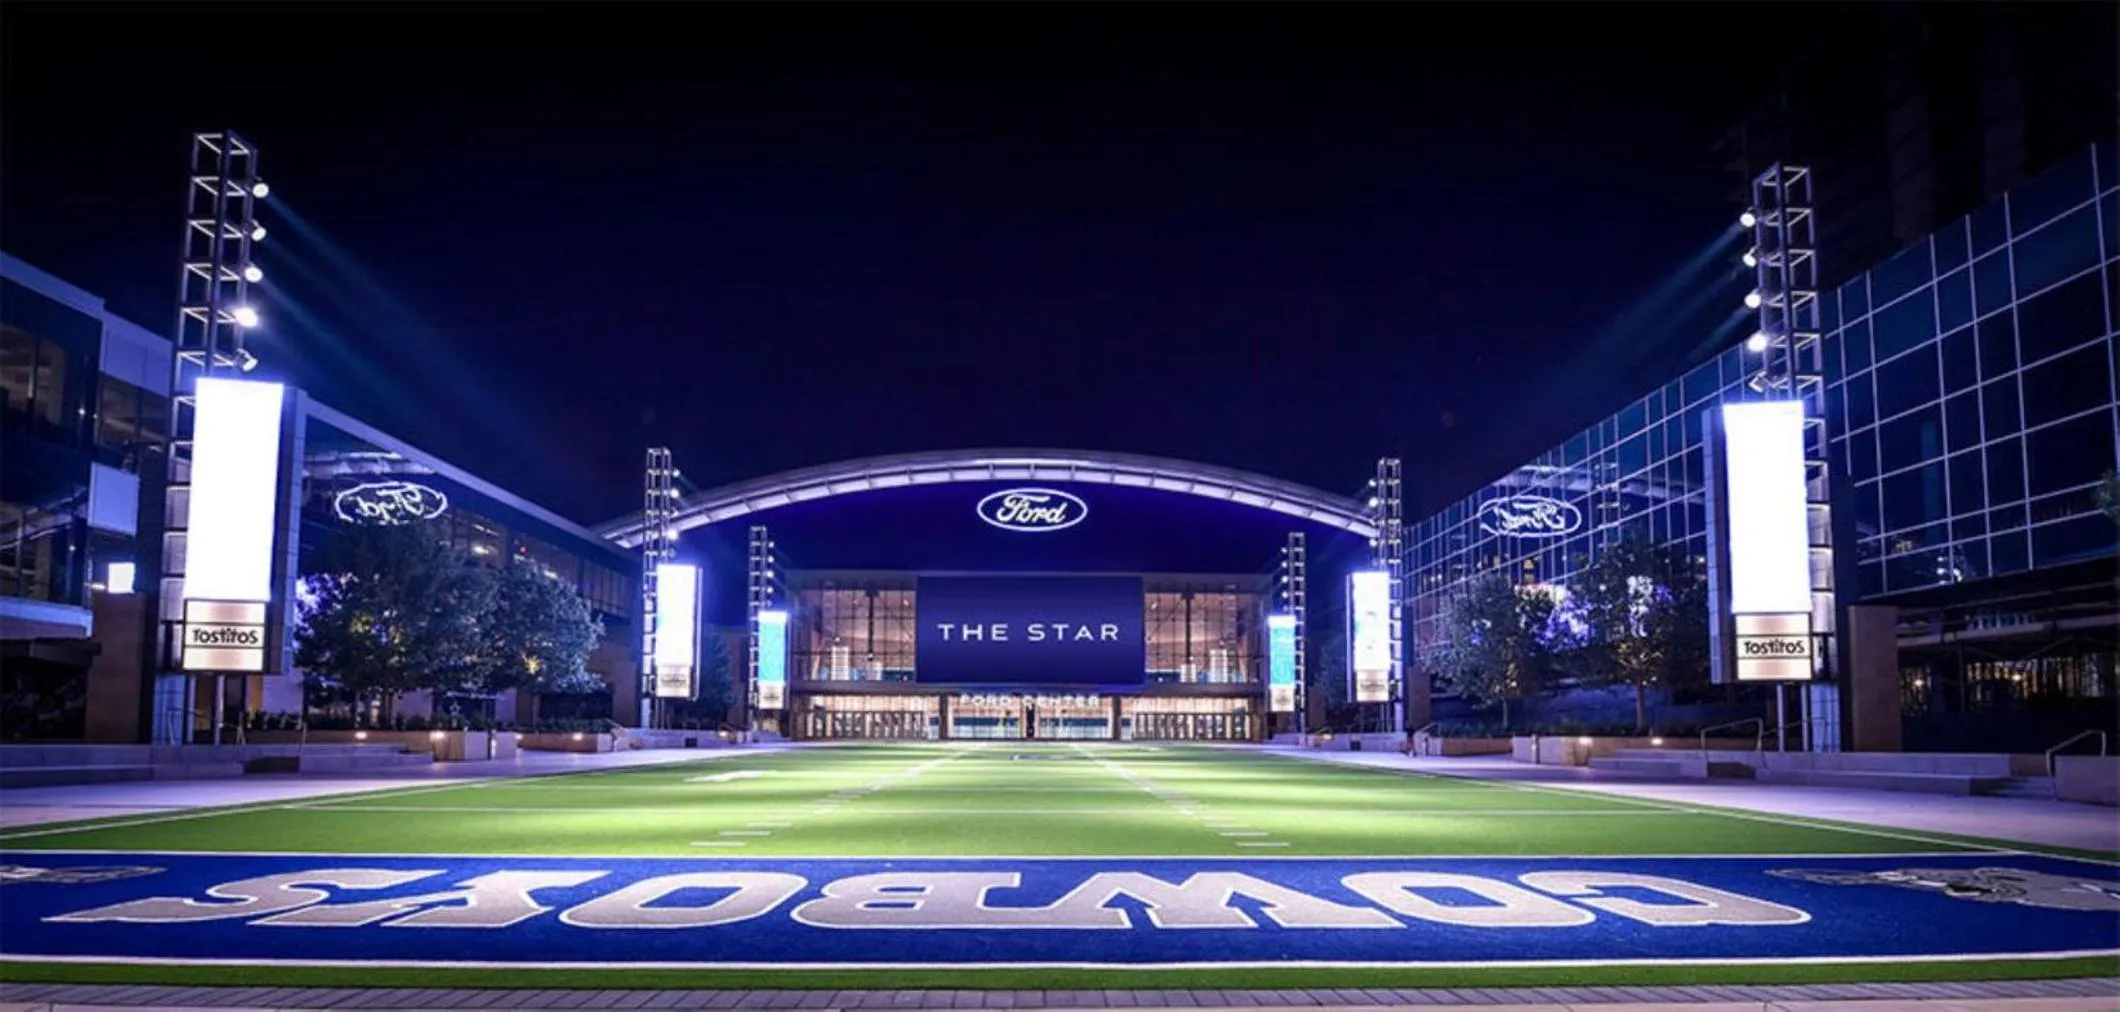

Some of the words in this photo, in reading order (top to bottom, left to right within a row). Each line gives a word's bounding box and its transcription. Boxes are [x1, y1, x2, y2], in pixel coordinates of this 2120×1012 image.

[996, 493, 1068, 523] Ford
[937, 623, 1009, 641] THE
[1027, 623, 1119, 641] STAR
[41, 867, 1812, 930] COWBOYS
